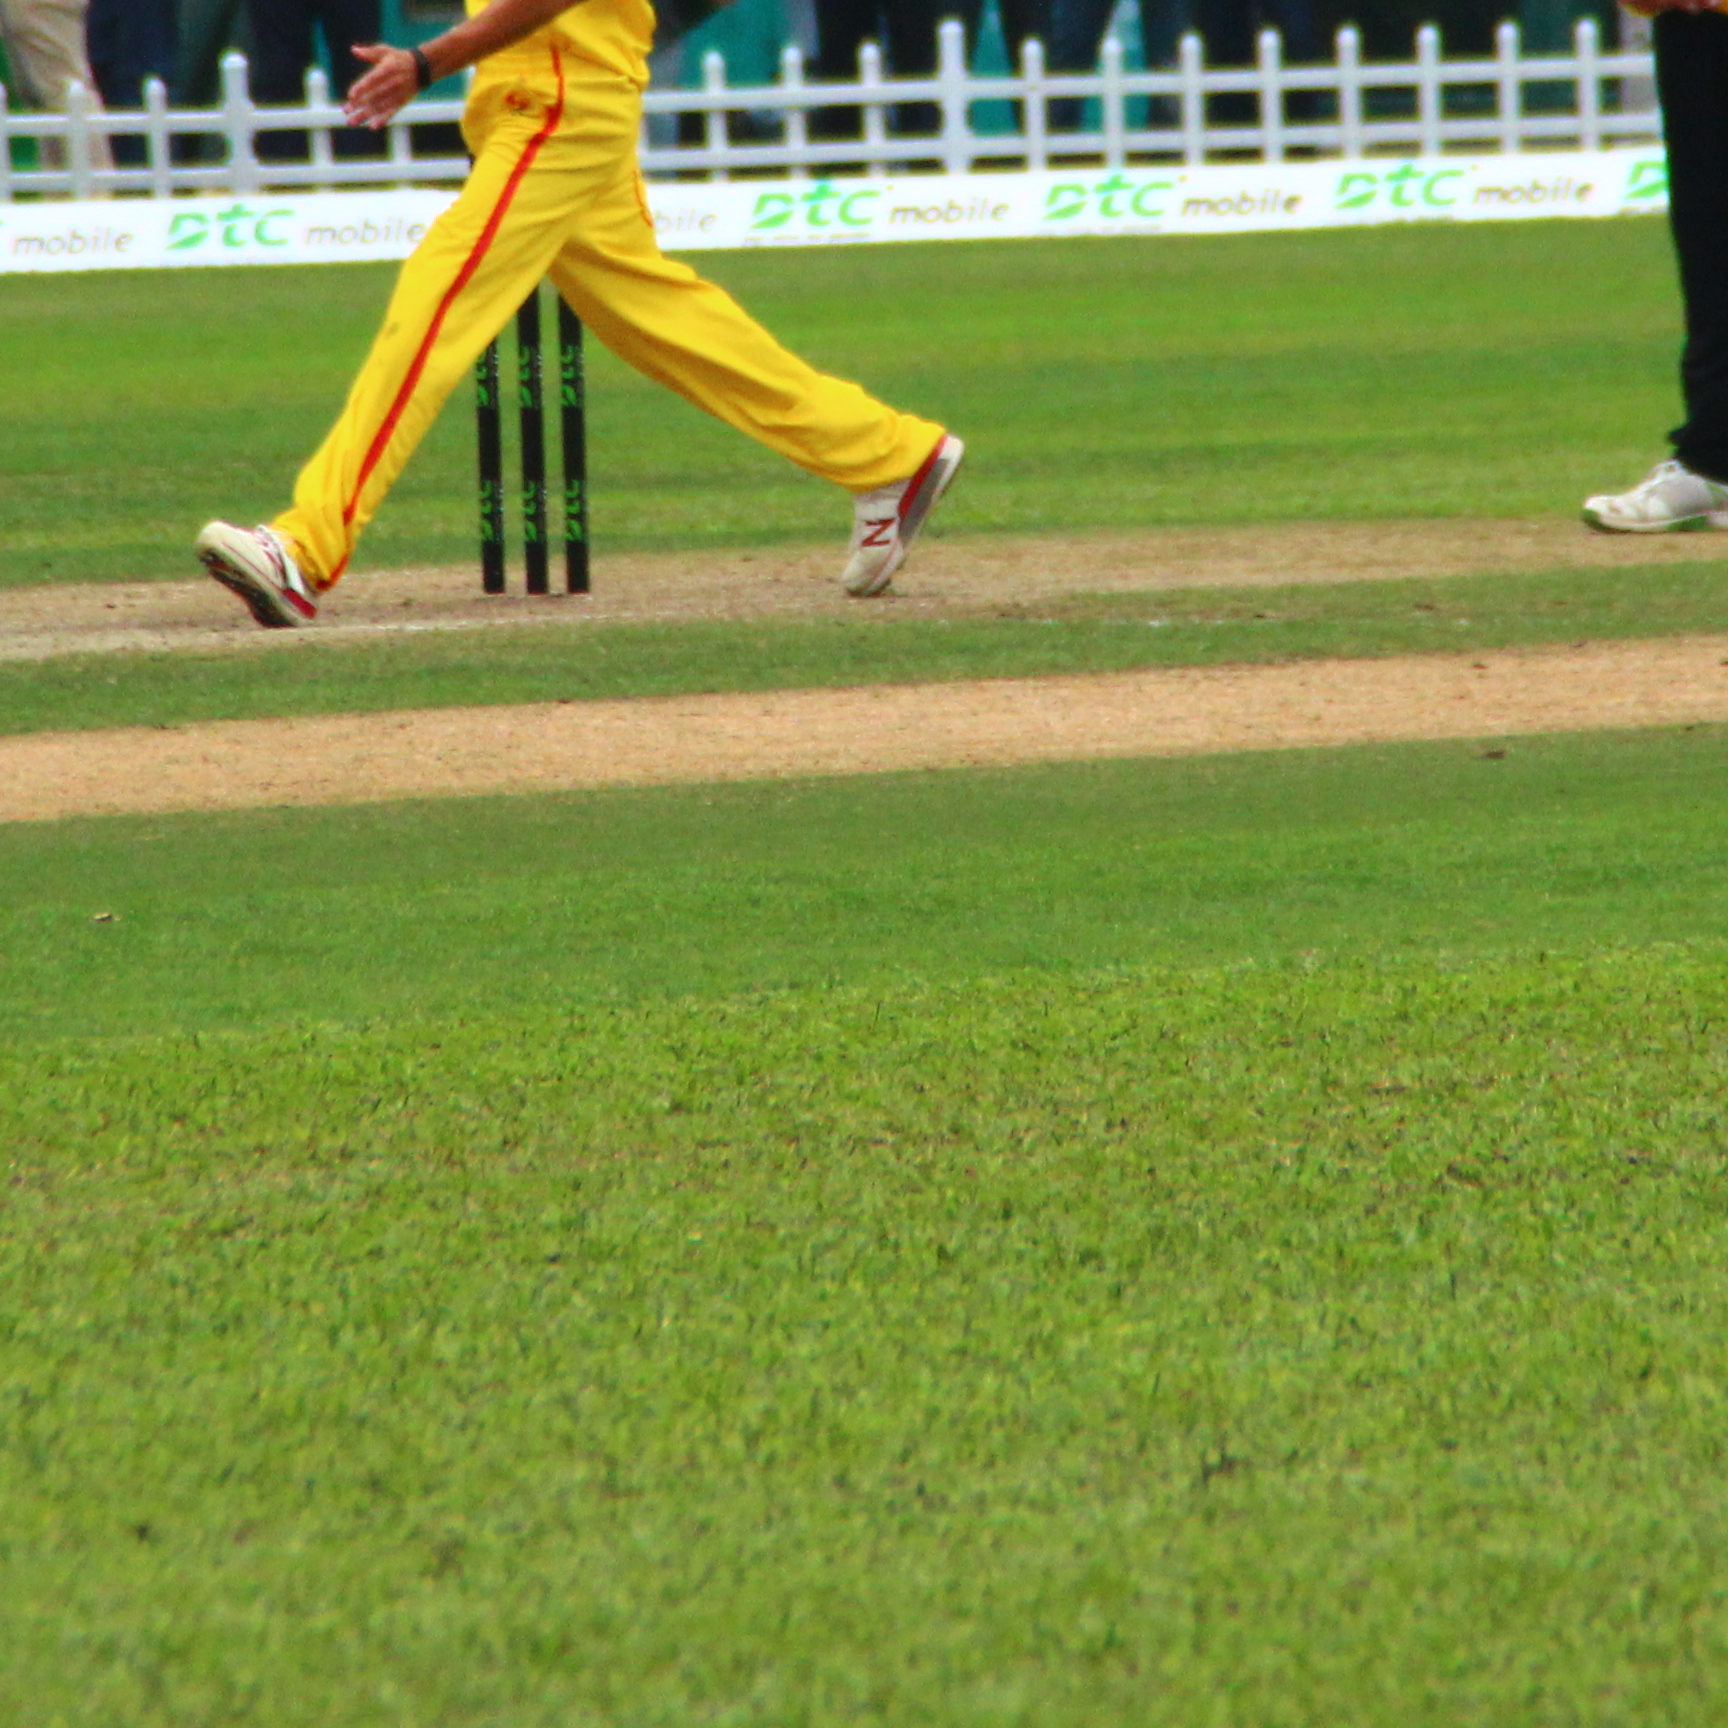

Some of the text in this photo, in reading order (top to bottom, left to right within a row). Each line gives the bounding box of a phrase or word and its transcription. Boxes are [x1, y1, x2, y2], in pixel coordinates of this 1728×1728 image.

[887, 186, 1010, 227] mobile
[1181, 180, 1303, 218] mobile
[1472, 167, 1595, 207] mobile
[12, 219, 134, 259] mobile
[304, 207, 425, 248] mobile
[652, 207, 719, 233] bile
